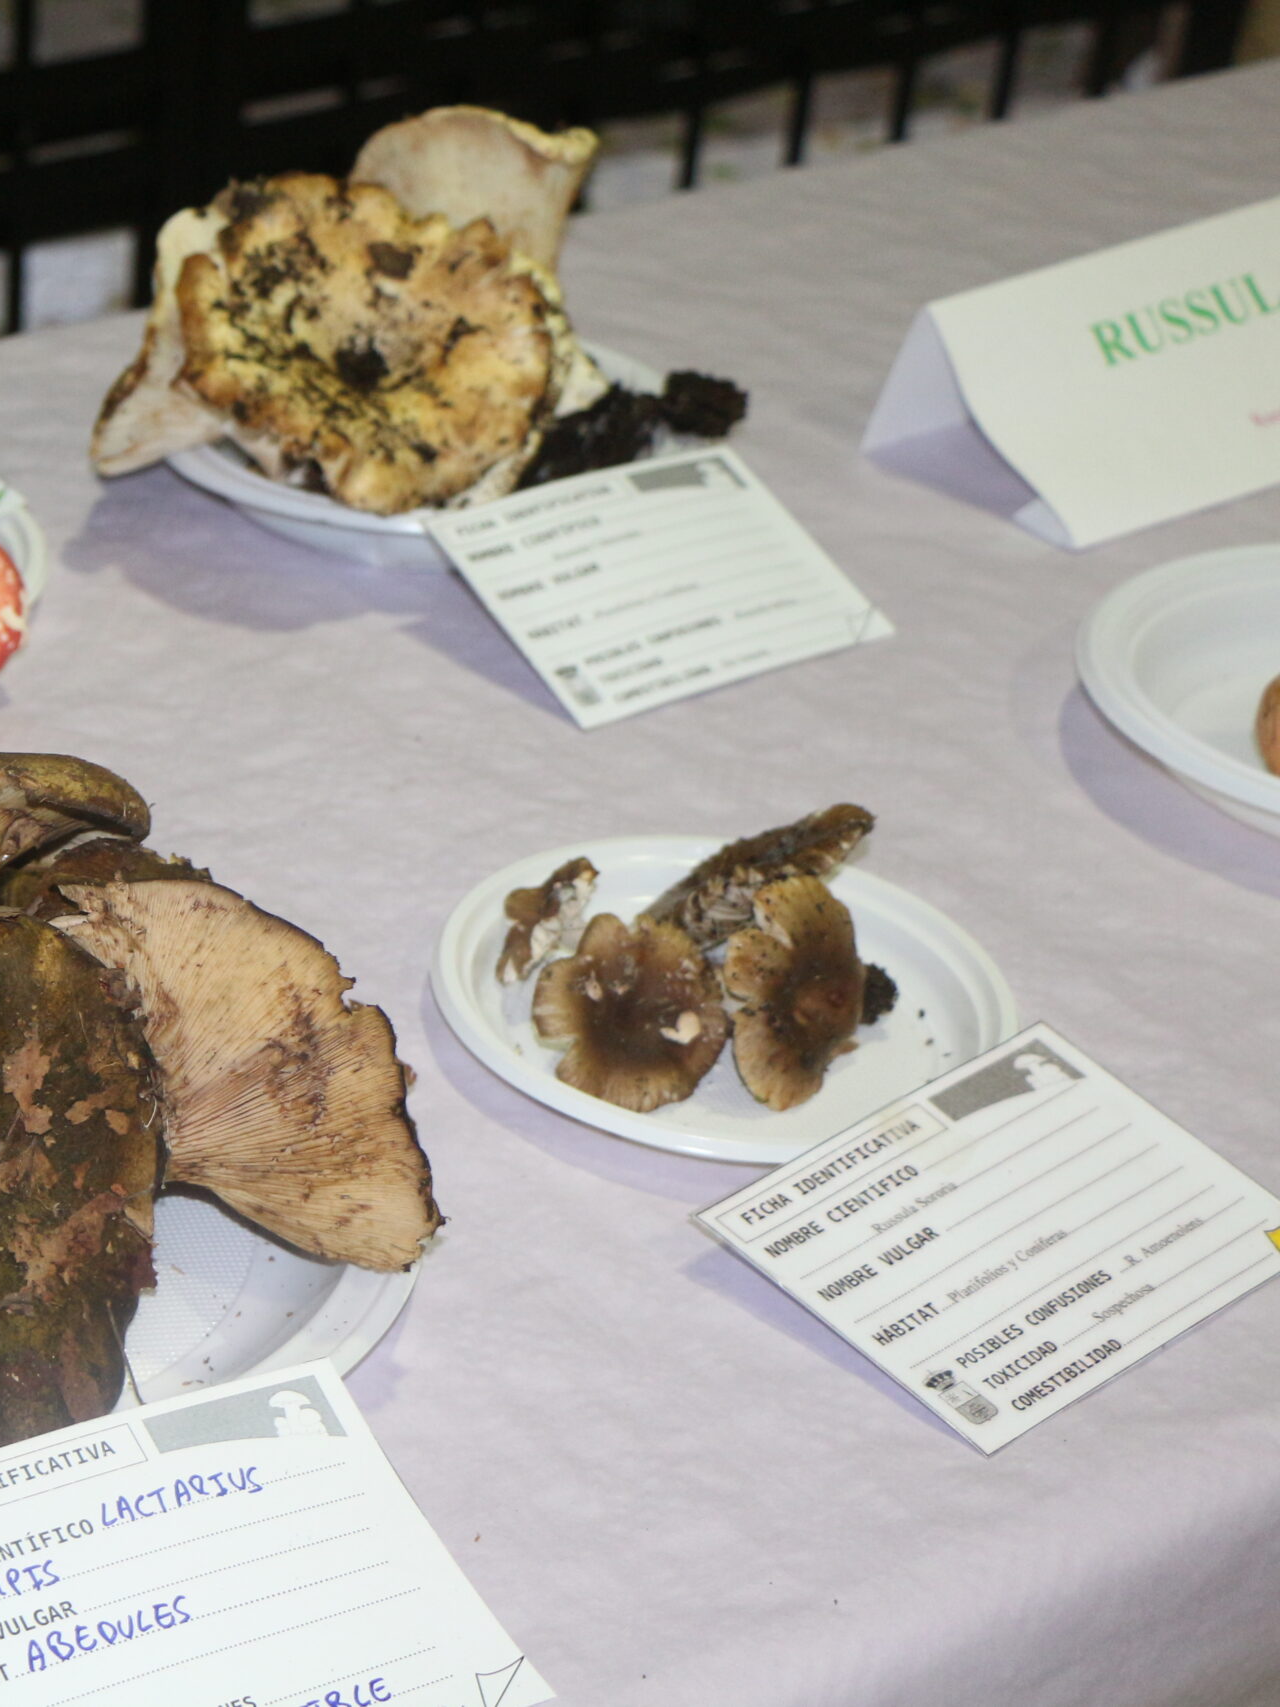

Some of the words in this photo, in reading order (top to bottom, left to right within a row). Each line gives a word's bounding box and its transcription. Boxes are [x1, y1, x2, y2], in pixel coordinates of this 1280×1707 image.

[1090, 274, 1280, 367] RUSSUL
[739, 1192, 793, 1226] FICHA
[792, 1119, 922, 1197] IDENTIFICATIVA
[763, 1220, 825, 1259] NOMBRE
[870, 1205, 920, 1236] Russula
[816, 1263, 879, 1302] NOMBRE
[876, 1226, 940, 1267] VULGAR
[955, 1323, 1025, 1370] POSIBLES
[1024, 1268, 1113, 1327] CONFUSIONES
[981, 1339, 1059, 1391] TOXICIDAD
[1010, 1337, 1123, 1412] COMESTIBILIDAD
[100, 1466, 263, 1527] LACTARIUS
[28, 1595, 191, 1672] ABEDULES
